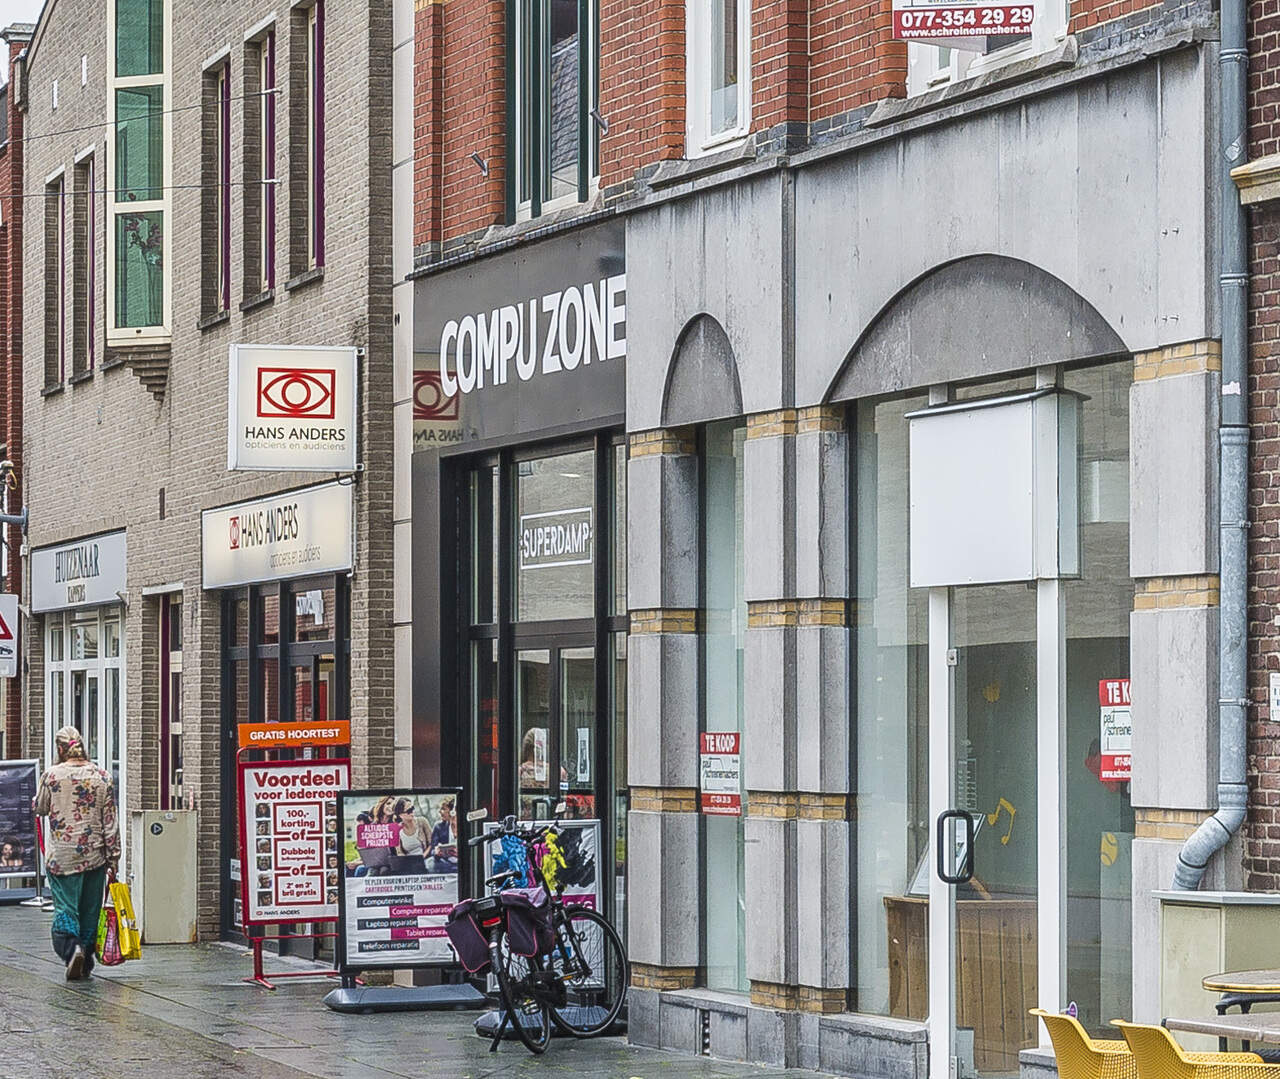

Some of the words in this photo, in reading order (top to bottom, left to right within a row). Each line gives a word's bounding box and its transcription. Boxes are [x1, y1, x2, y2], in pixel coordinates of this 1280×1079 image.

[901, 9, 976, 28] 077-354
[981, 8, 1005, 25] 29
[1010, 7, 1033, 24] 29
[245, 426, 285, 440] HANS
[288, 427, 346, 441] ANDERS
[245, 441, 287, 451] opticiens
[303, 442, 346, 451] audiciens
[241, 510, 263, 549] HANS
[264, 503, 299, 545] ANDERS
[523, 522, 589, 558] SUPERDAMP
[55, 544, 99, 583] HUIZENAAR
[1107, 681, 1121, 704] TE
[249, 730, 286, 741] GRATIS
[287, 728, 340, 739] HOORTEST
[1107, 724, 1132, 736] schreine
[705, 734, 715, 752] TE
[715, 734, 736, 752] KOOP
[253, 769, 340, 788] Voordeel
[254, 790, 282, 800] voor
[280, 819, 316, 829] korting
[291, 828, 306, 841] of
[281, 847, 316, 856] Dubbele
[291, 863, 306, 876] of
[295, 888, 317, 898] gratis
[391, 907, 423, 916] Computer
[365, 920, 389, 929] Laptop
[405, 928, 425, 937] Tablet
